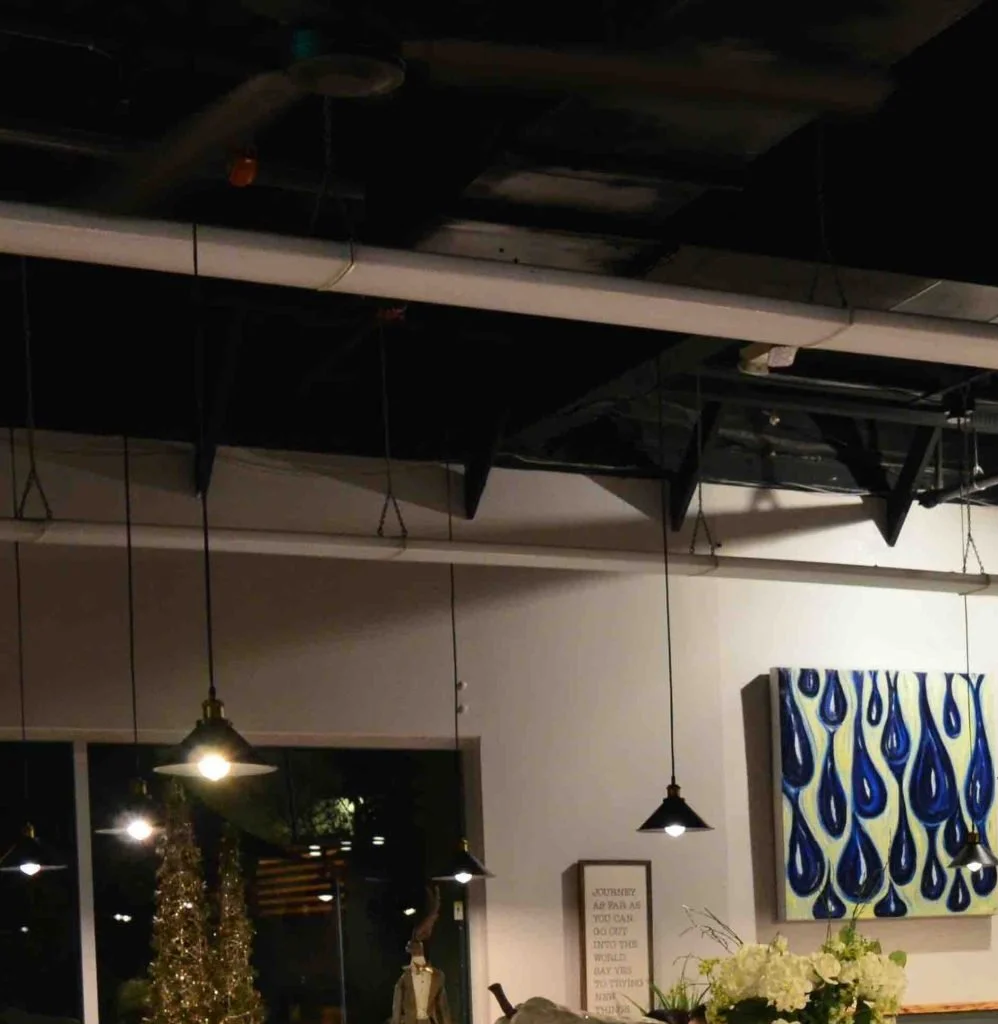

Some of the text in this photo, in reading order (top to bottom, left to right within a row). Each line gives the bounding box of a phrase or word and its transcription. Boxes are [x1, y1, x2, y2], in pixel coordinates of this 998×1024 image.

[592, 888, 636, 897] JOURNEY
[593, 901, 641, 910] AS FAR AS
[593, 914, 611, 923] YOU
[609, 926, 628, 936] OUT
[593, 940, 638, 949] INTO THE
[593, 966, 632, 975] SAY YES
[593, 979, 644, 988] TO TRYING
[595, 993, 616, 1001] NEW
